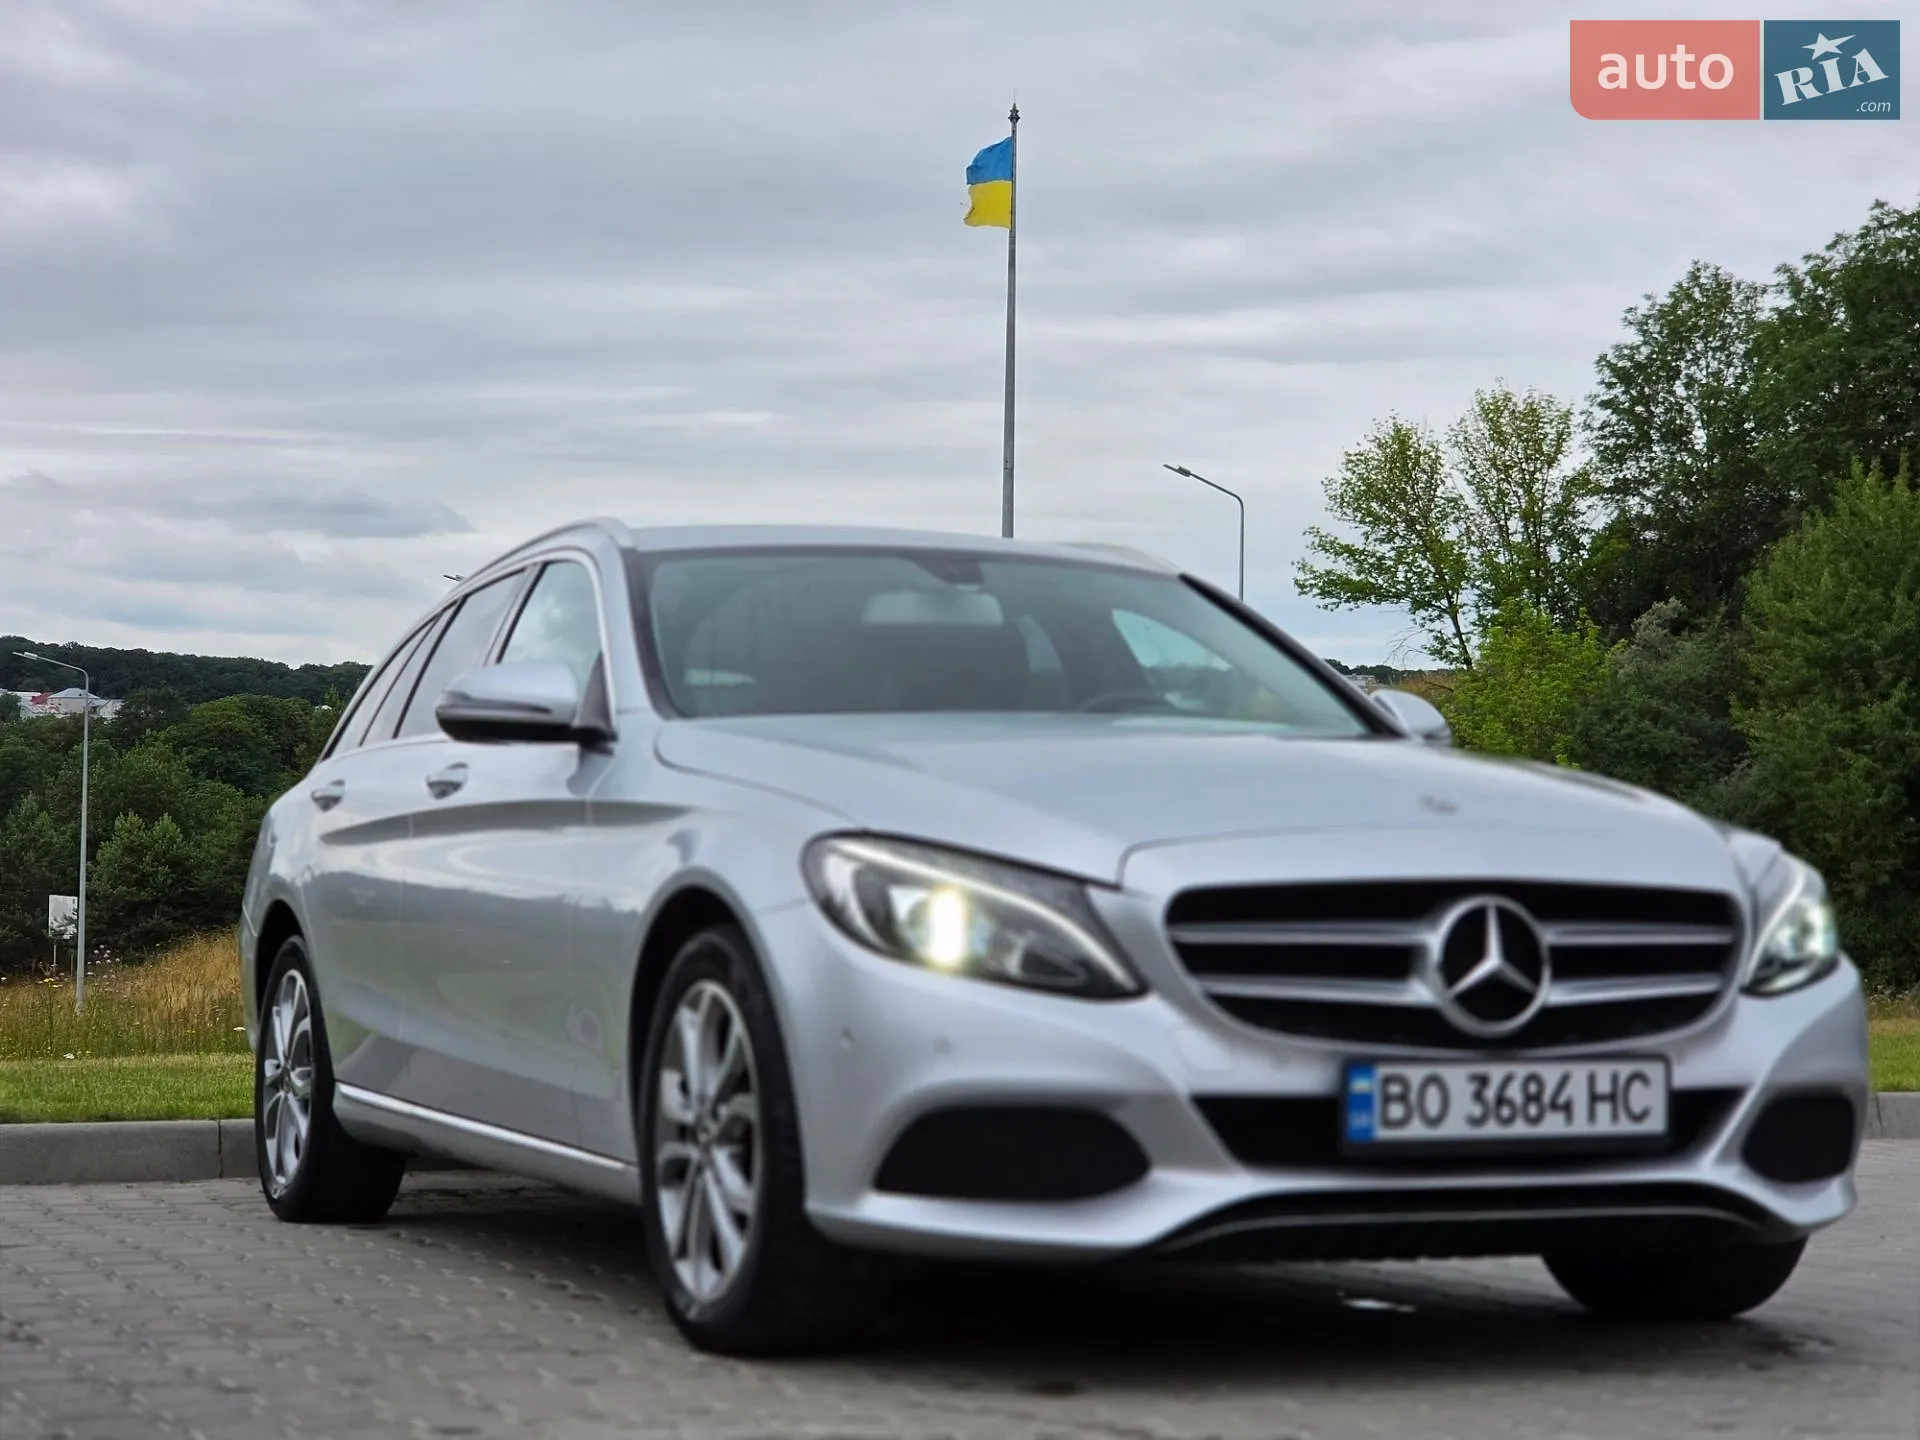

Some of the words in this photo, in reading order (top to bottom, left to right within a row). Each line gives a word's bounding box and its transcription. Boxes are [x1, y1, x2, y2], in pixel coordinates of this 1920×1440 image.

[1379, 1073, 1451, 1129] BO
[1465, 1071, 1574, 1128] 3684
[1587, 1069, 1652, 1125] HC
